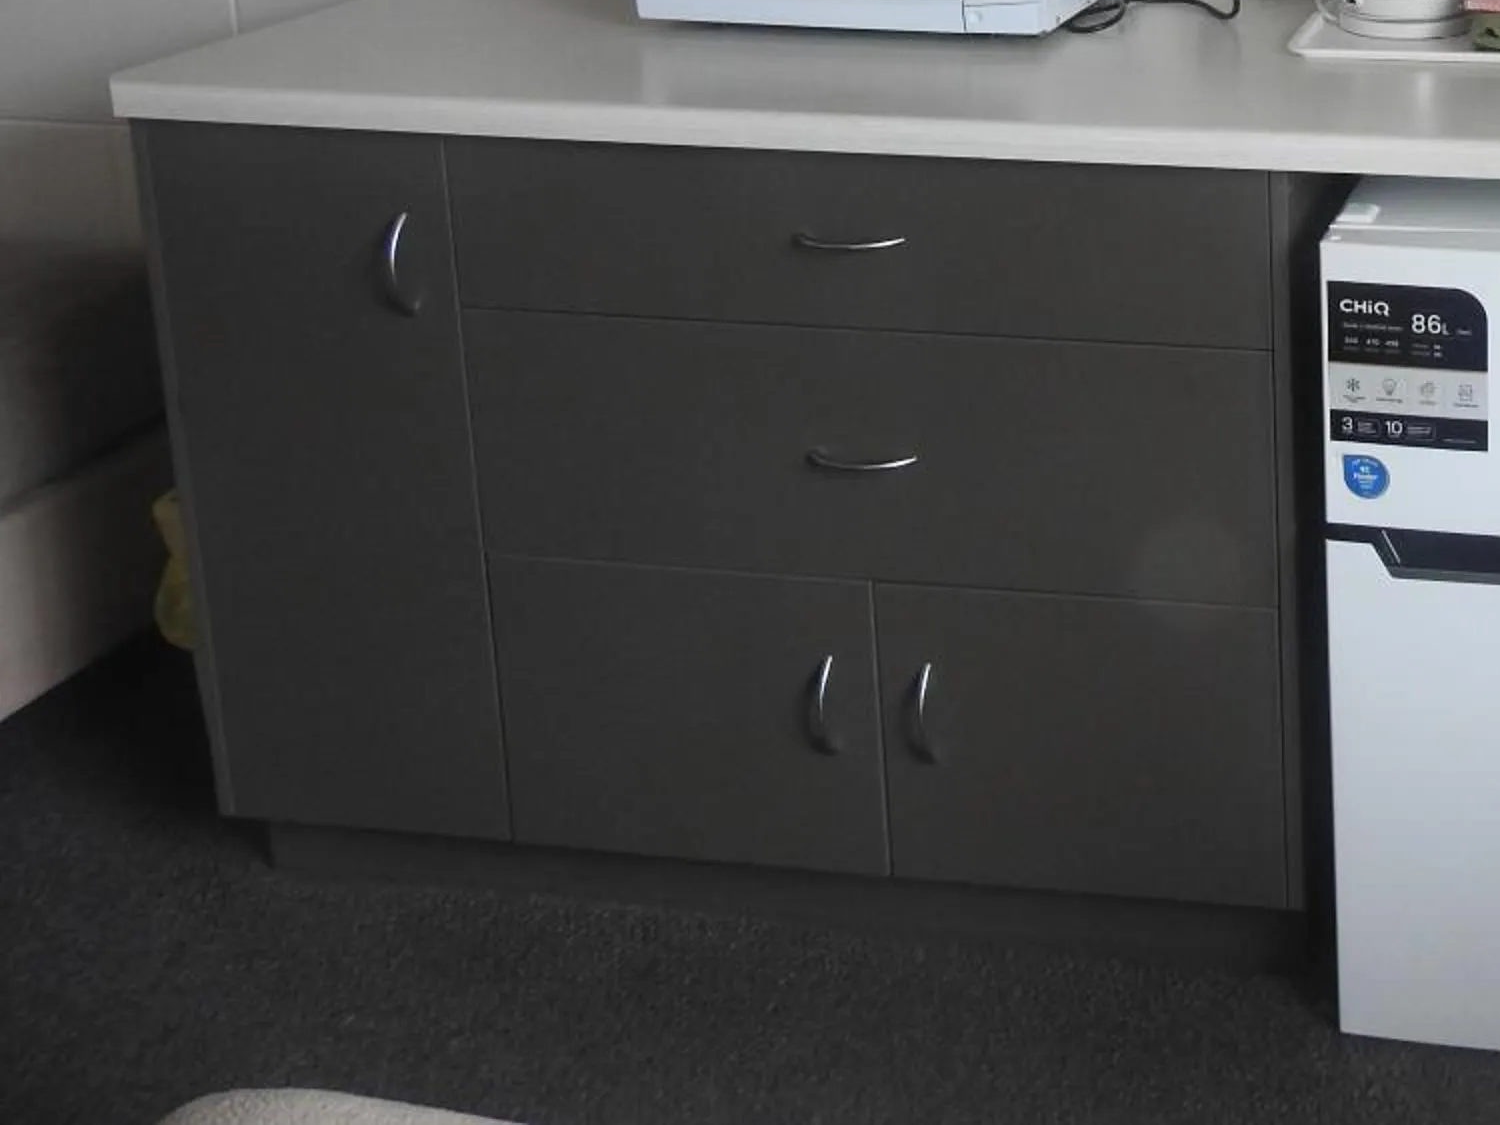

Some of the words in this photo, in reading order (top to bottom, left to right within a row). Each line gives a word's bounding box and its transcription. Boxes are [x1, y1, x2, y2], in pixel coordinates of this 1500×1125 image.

[1339, 298, 1390, 317] CHiQ
[1342, 416, 1353, 431] 3
[1385, 420, 1403, 435] 10
